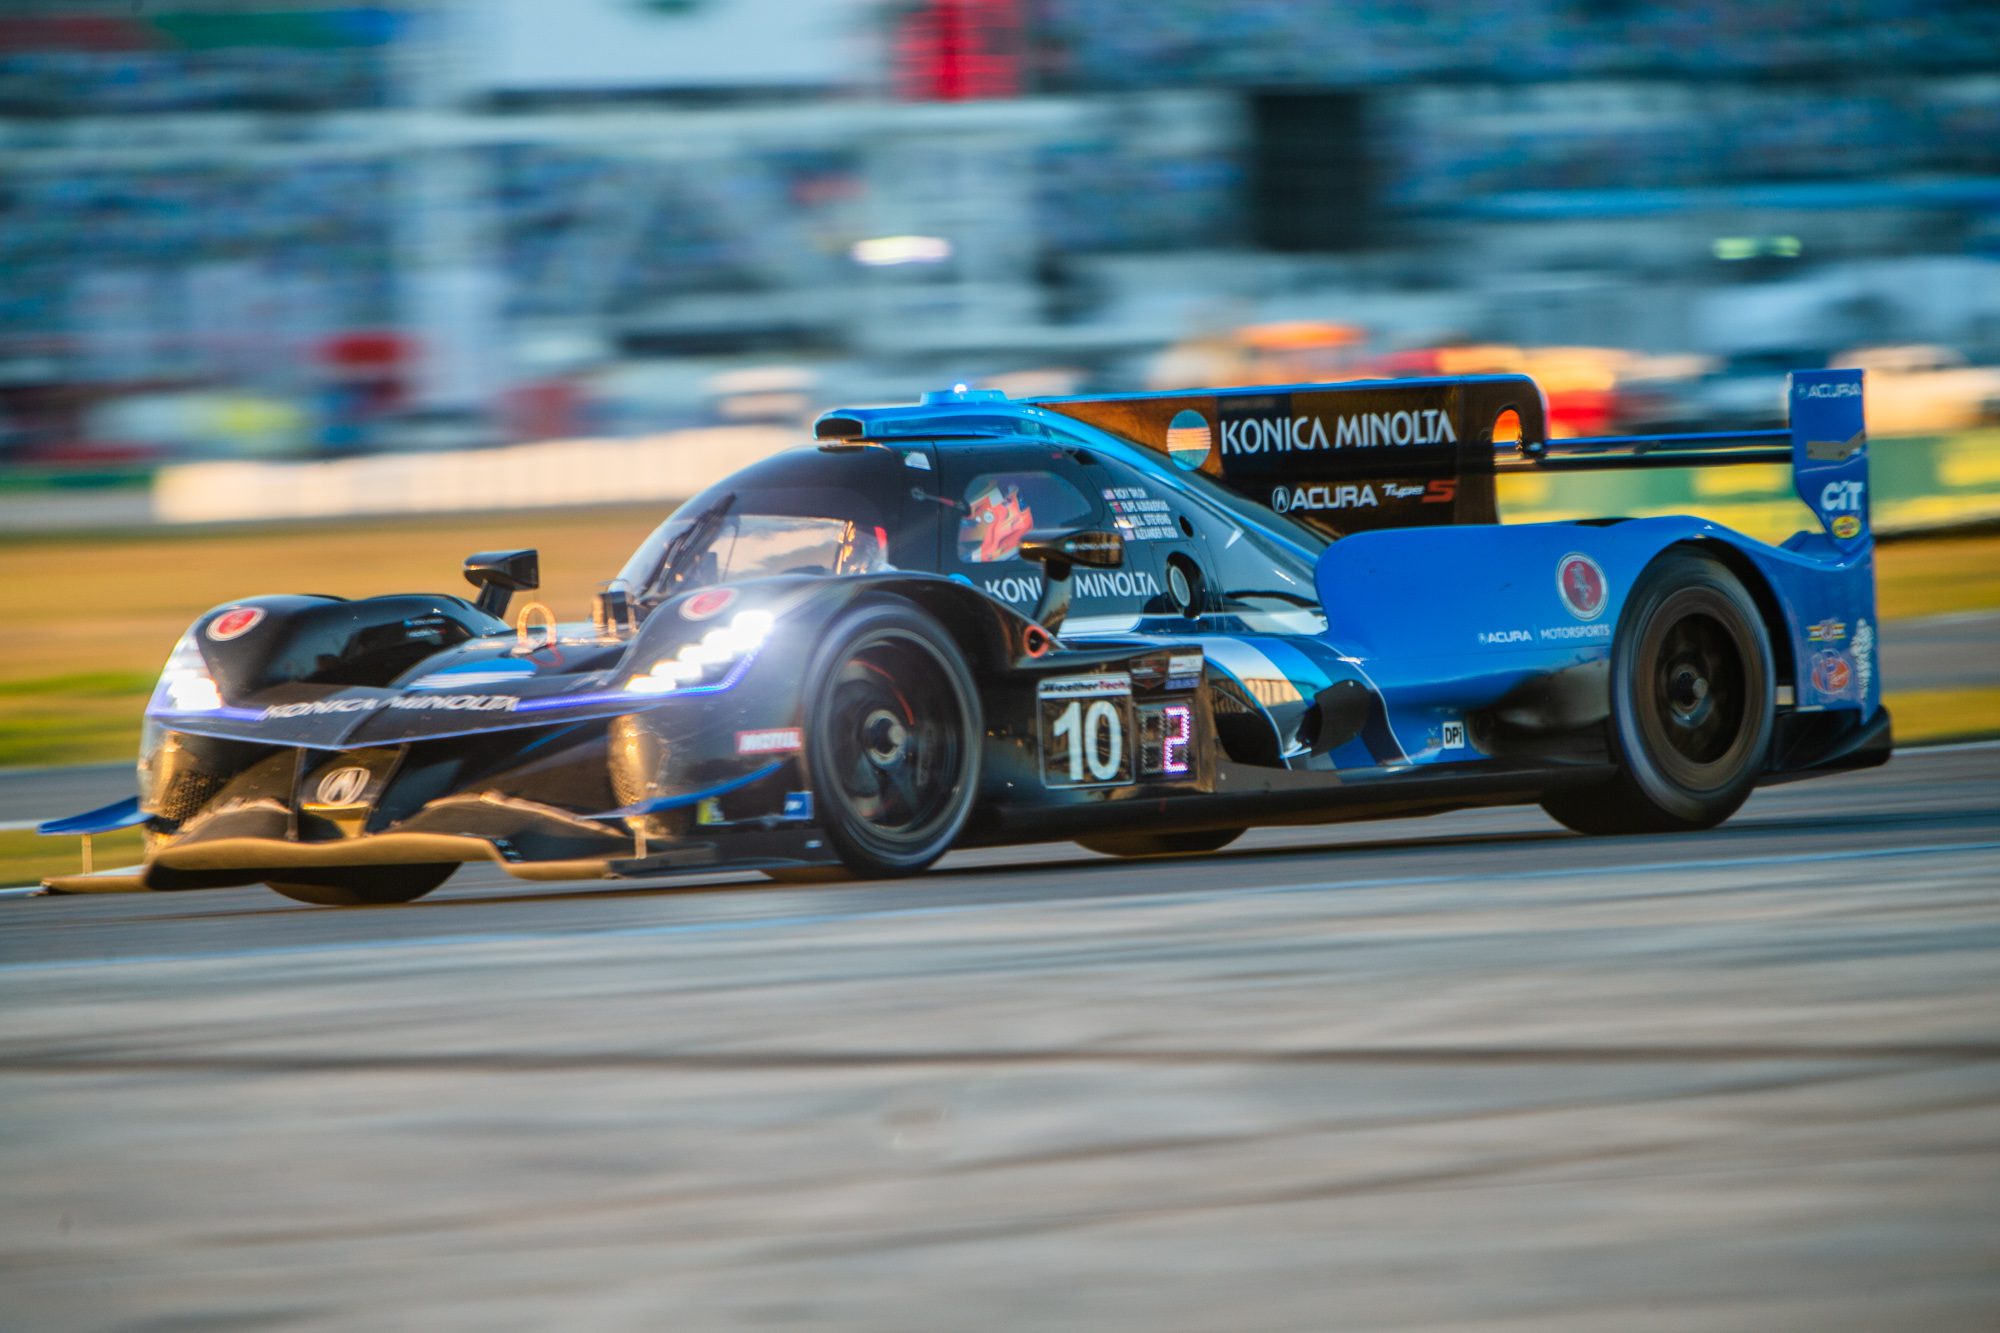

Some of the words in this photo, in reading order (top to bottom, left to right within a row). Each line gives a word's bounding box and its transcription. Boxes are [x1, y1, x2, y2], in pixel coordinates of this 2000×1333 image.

[1808, 383, 1862, 398] ACURA
[1220, 415, 1328, 455] KONICA
[1334, 409, 1456, 448] MINOLTA
[1290, 485, 1379, 511] ACURA
[1382, 483, 1425, 498] Type
[1421, 480, 1457, 502] S
[985, 577, 1044, 603] KONI
[1076, 572, 1160, 599] MINOLTA
[1488, 629, 1532, 643] ACURA
[1540, 624, 1610, 640] MOTORSPORTS
[257, 697, 378, 720] KONICA
[1053, 700, 1123, 781] 10
[1163, 706, 1190, 774] 2
[1445, 726, 1463, 745] DPi
